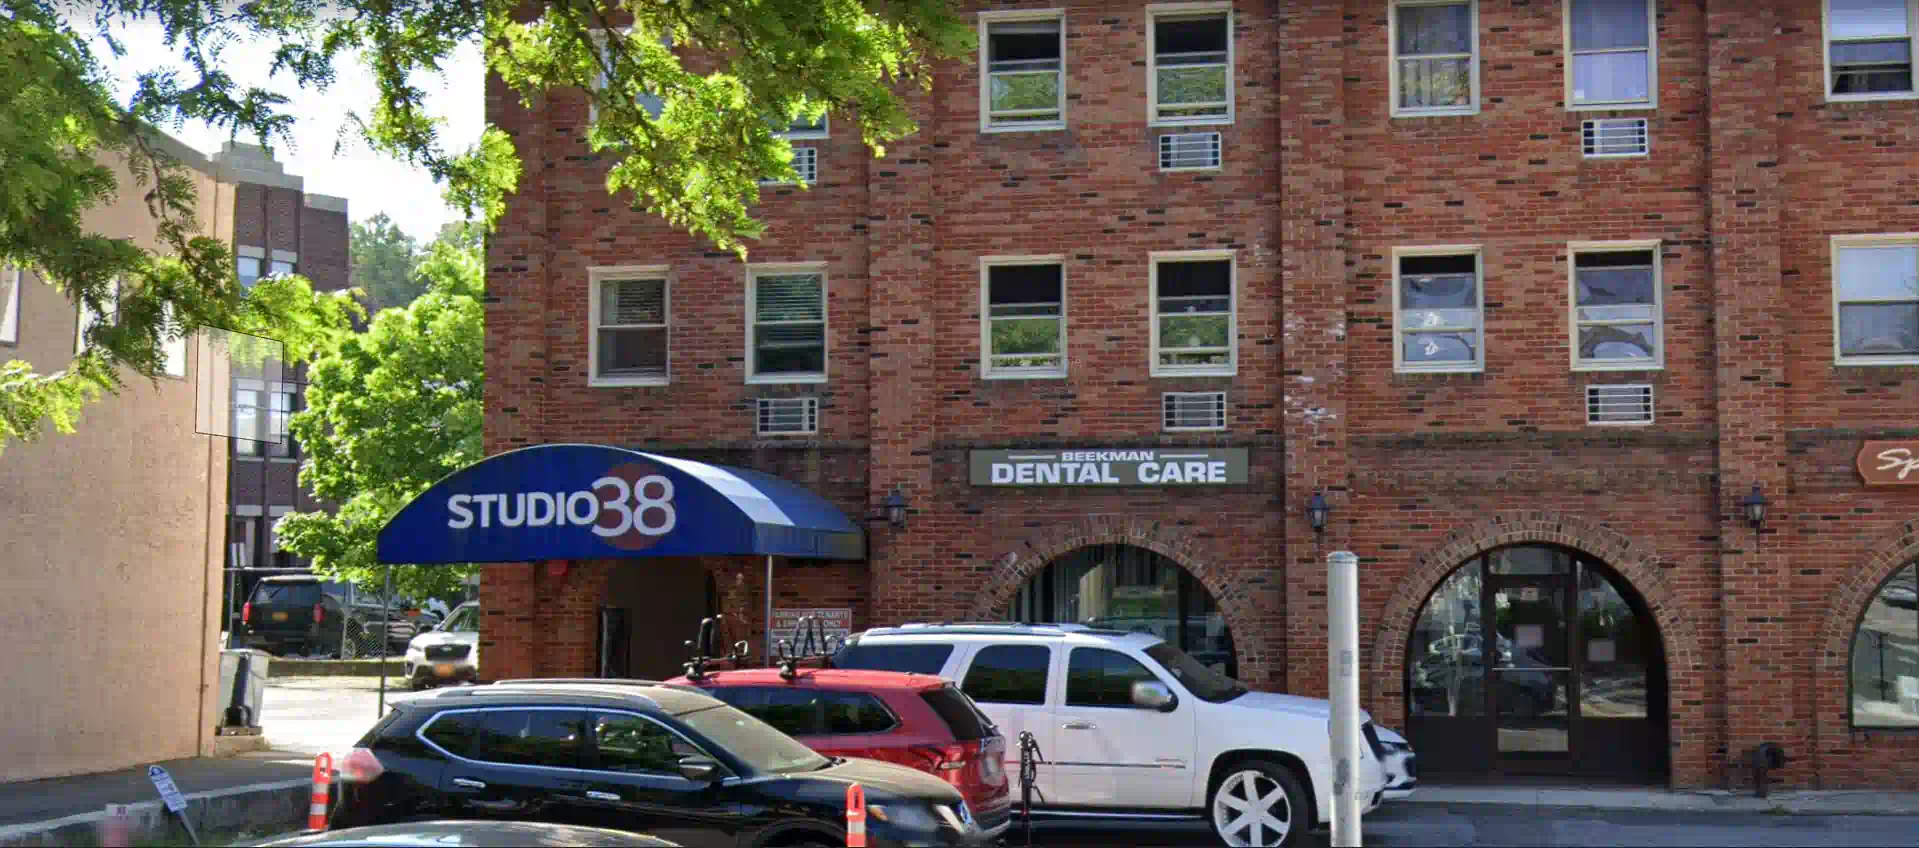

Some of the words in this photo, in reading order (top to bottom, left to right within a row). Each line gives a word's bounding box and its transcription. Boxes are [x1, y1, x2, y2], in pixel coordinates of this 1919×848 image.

[1061, 451, 1154, 462] BEEKMAN
[991, 462, 1120, 485] DENTAL
[1137, 461, 1227, 485] CARE
